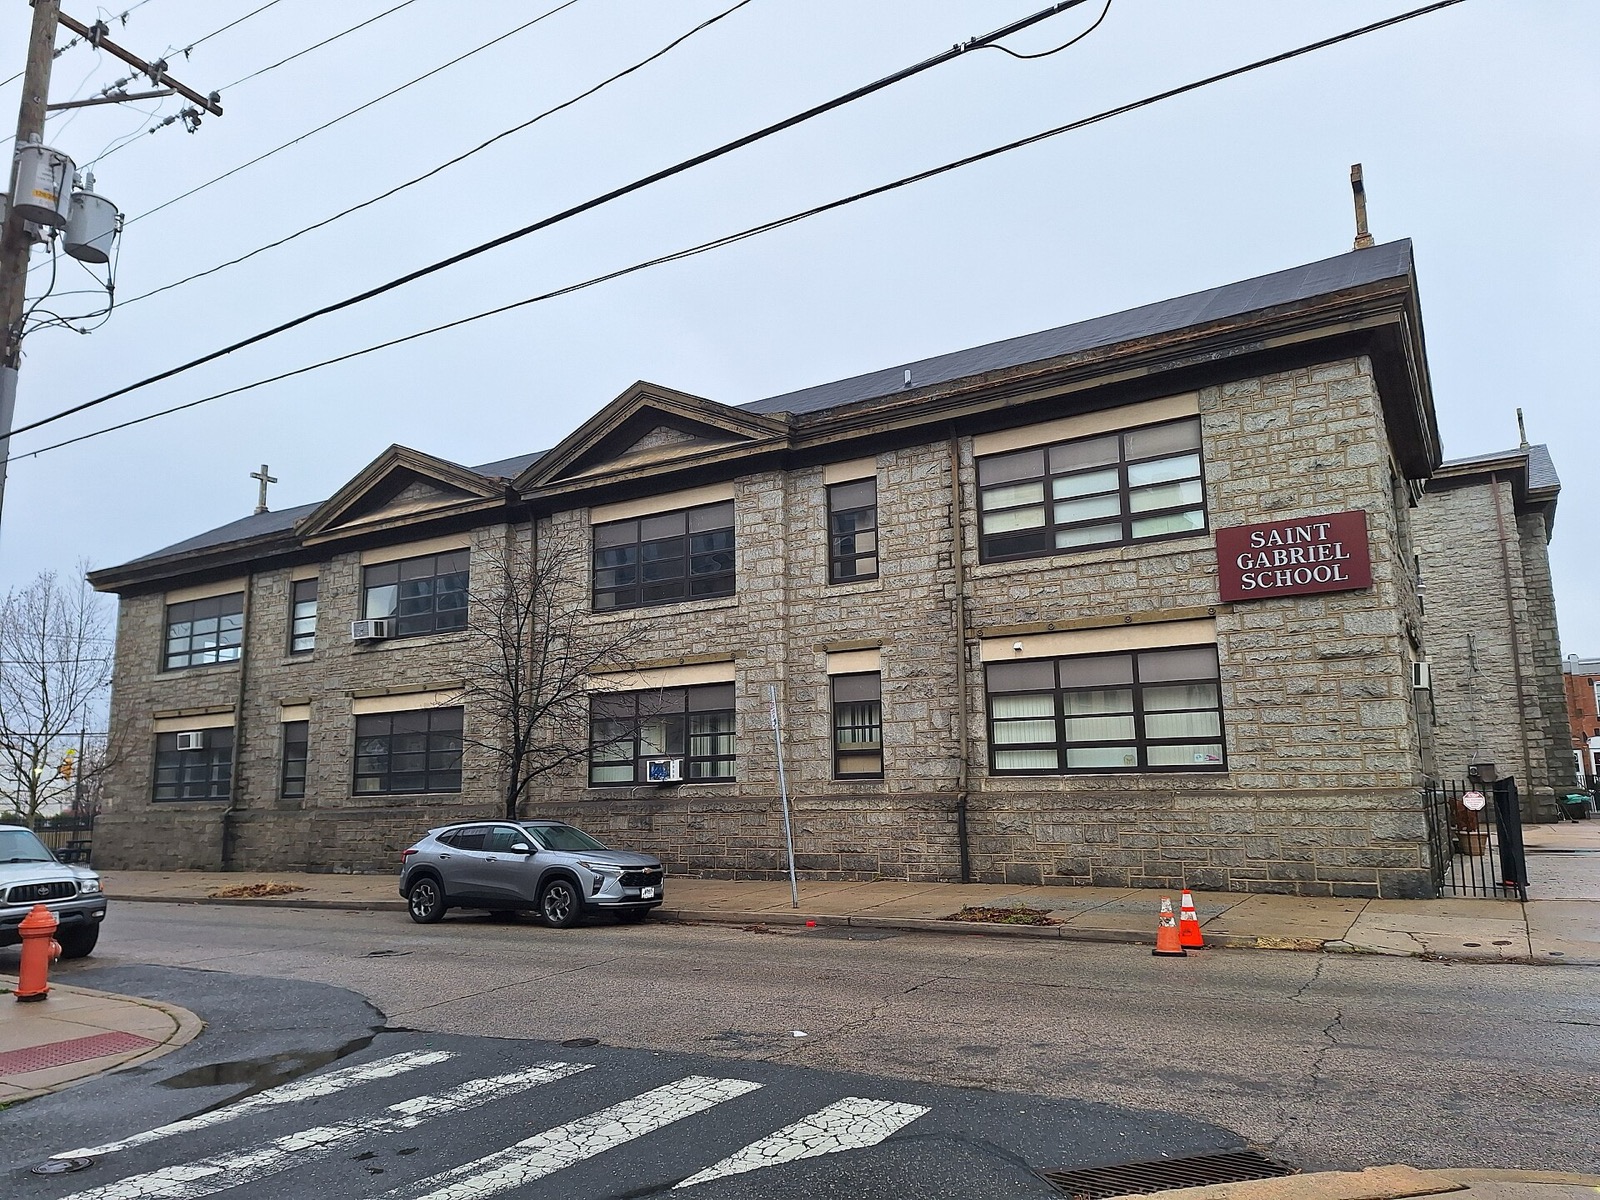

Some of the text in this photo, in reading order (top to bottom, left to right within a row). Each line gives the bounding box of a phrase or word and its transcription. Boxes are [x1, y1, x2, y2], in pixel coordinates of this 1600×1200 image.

[1250, 522, 1331, 549] SAINT
[1236, 542, 1350, 570] GABRIEL
[1241, 563, 1349, 590] SCHOOL
